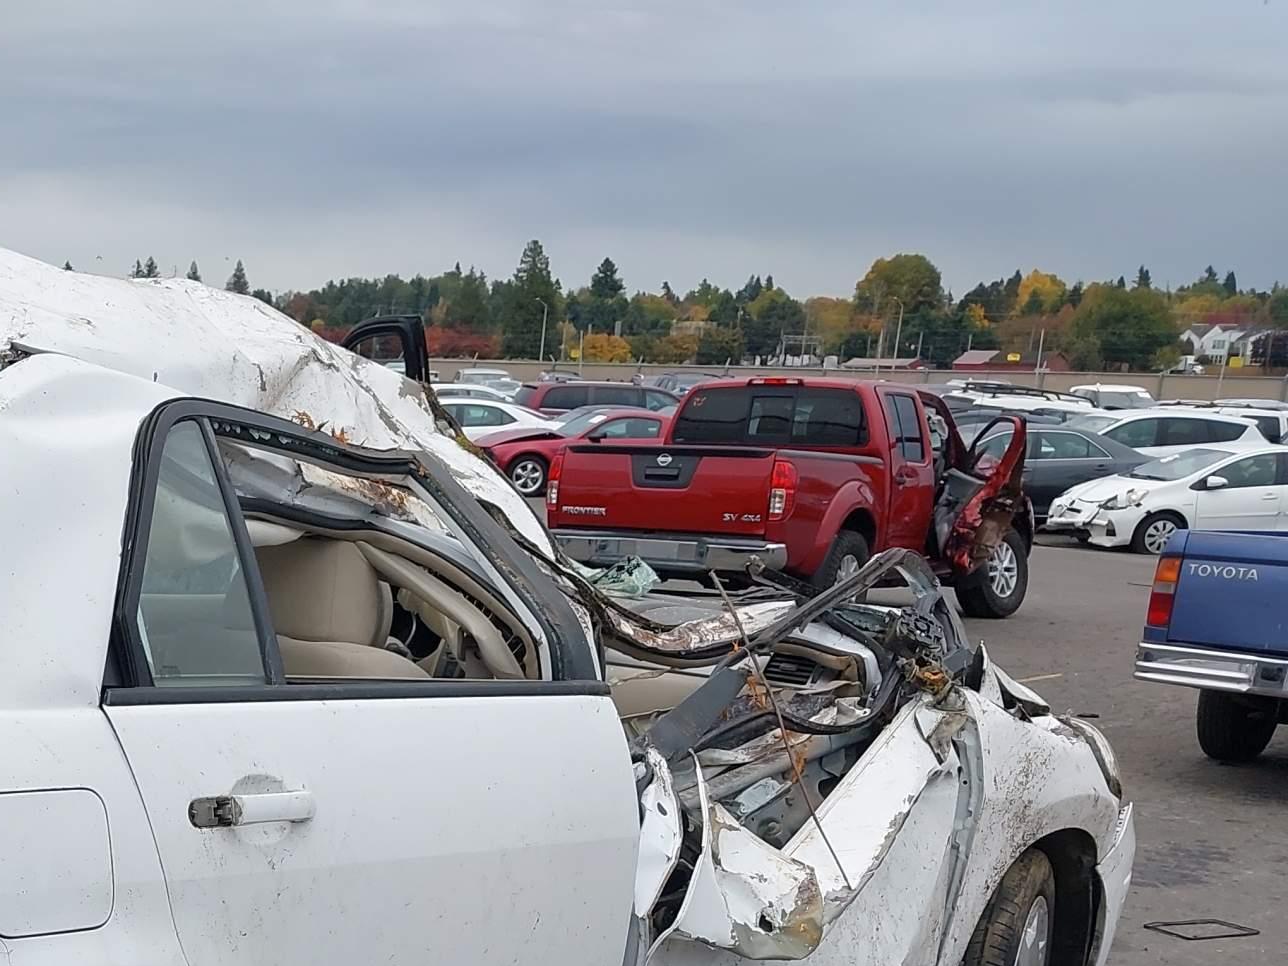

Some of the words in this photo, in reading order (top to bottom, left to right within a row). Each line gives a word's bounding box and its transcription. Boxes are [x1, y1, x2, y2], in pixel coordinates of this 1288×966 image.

[562, 505, 606, 516] FRONTIER
[722, 512, 738, 522] SV
[1189, 563, 1258, 581] TOYOTA
